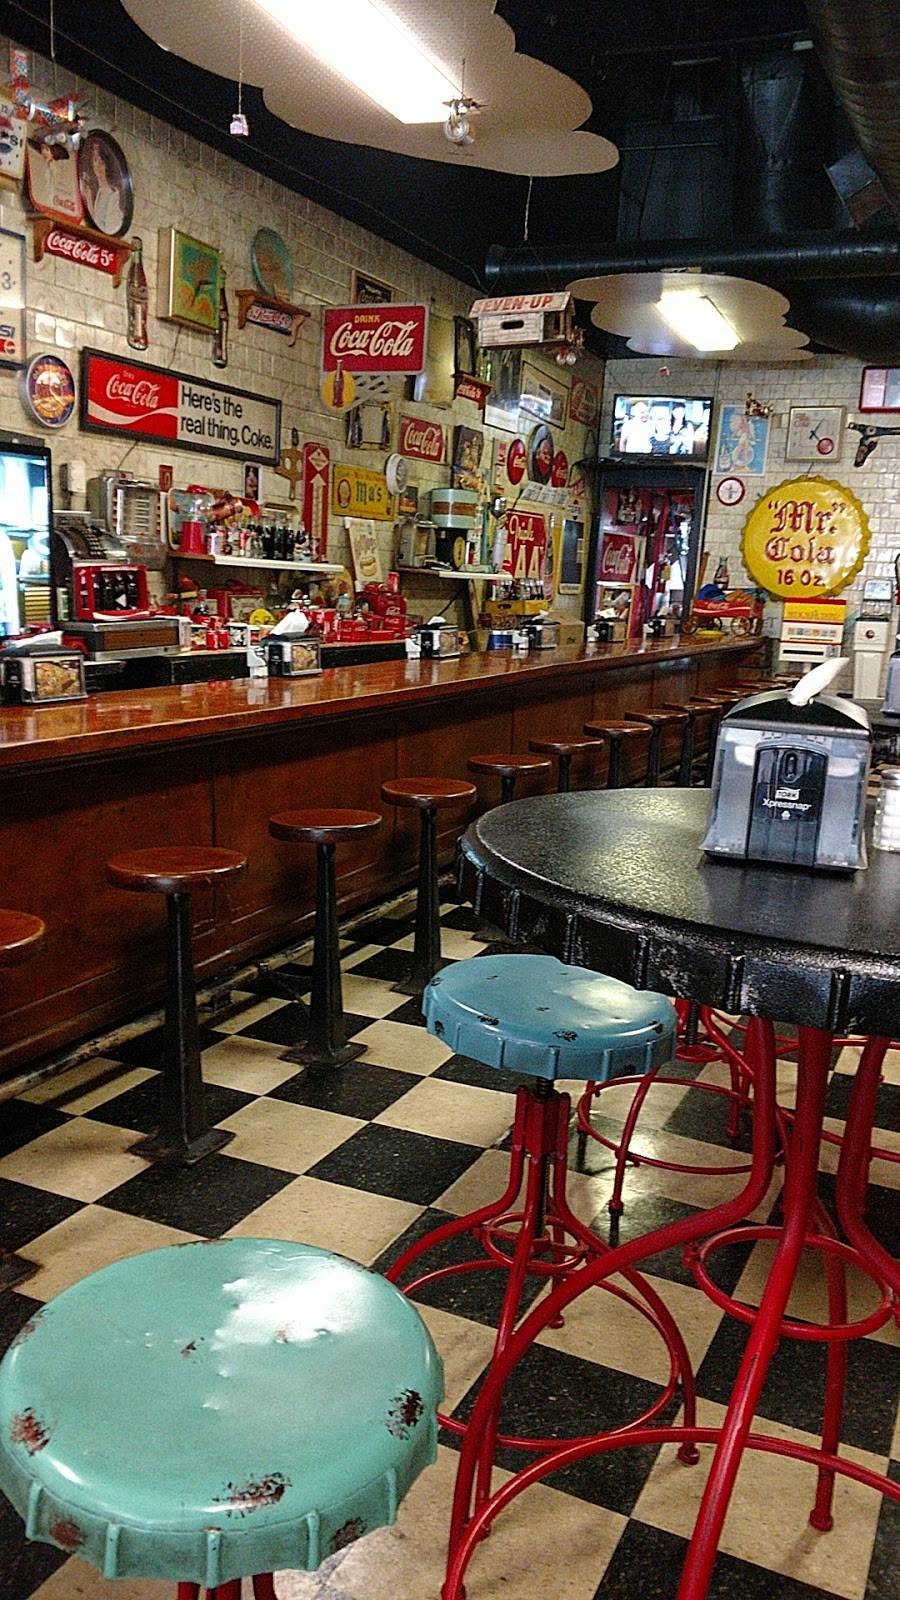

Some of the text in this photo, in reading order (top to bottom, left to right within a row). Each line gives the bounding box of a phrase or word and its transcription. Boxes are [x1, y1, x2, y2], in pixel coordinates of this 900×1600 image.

[472, 294, 554, 314] SEVEN-UP
[354, 314, 381, 324] DRINK
[329, 320, 420, 357] Coca-Cola
[181, 385, 242, 419] Here's the
[180, 416, 274, 450] real thing. Coke.
[765, 536, 835, 565] Cola
[777, 569, 794, 586] 16
